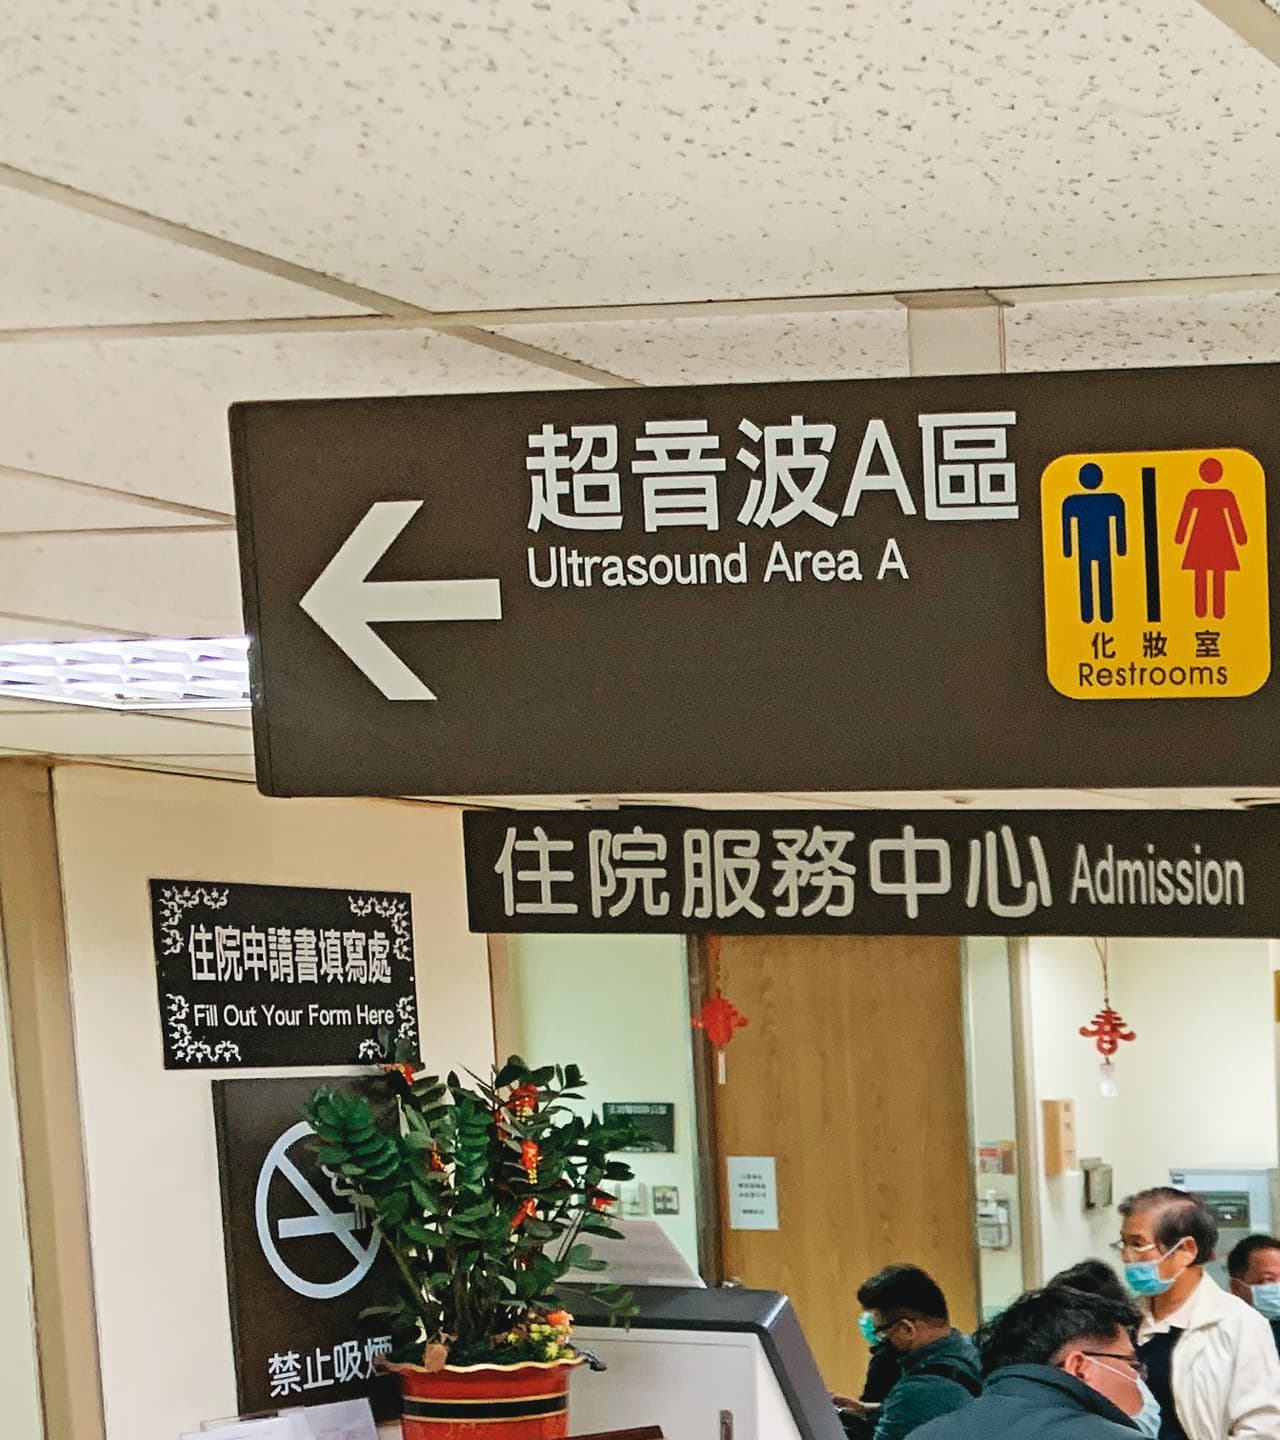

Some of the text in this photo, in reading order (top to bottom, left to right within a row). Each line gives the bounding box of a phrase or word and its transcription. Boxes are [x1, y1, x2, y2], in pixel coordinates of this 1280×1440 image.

[526, 411, 1021, 534] 超音波A區
[528, 539, 911, 589] Ultrasound Area A
[1092, 631, 1222, 660] 化妝室
[1080, 664, 1229, 688] Restrooms
[495, 826, 1053, 920] 住院服務中心
[1071, 845, 1245, 906] Admission
[188, 924, 393, 986] 住院申請書填寫處
[194, 1003, 395, 1028] Fill Out Your Form Here
